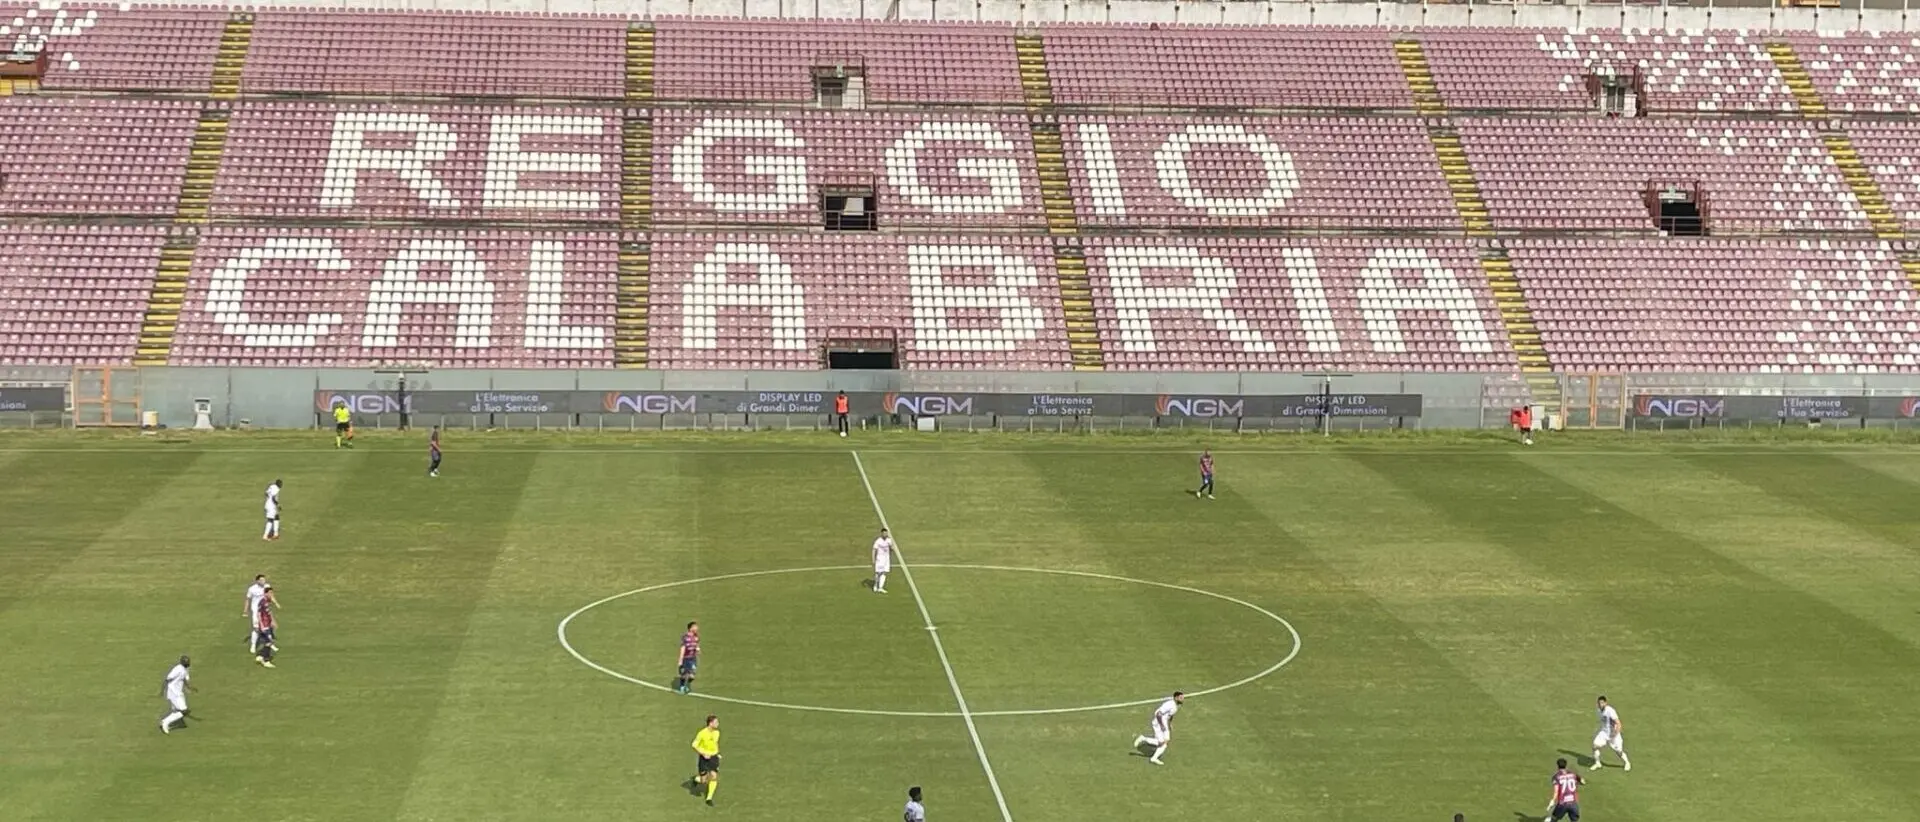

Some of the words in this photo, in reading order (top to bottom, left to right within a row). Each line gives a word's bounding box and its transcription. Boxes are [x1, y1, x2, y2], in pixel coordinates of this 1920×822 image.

[319, 111, 1300, 219] REGGIO
[204, 237, 1493, 353] CALABRIA
[327, 394, 412, 413] NGM
[615, 394, 696, 413] NGM
[760, 392, 801, 402] DISPLAY
[804, 392, 822, 402] LED
[1348, 395, 1366, 405] LED
[484, 403, 502, 412] Tuo
[505, 402, 548, 412] Servizio
[736, 402, 747, 412] di
[750, 402, 785, 412] Grandi
[894, 396, 973, 415] NGM
[1042, 406, 1058, 415] Tuo
[1165, 398, 1243, 417] NGM
[1282, 406, 1292, 415] di
[1333, 405, 1388, 415] Dimensioni
[1648, 399, 1724, 417] NGM
[1791, 407, 1806, 417] Tuo
[1810, 407, 1849, 417] Servizio
[1559, 779, 1577, 794] 70
